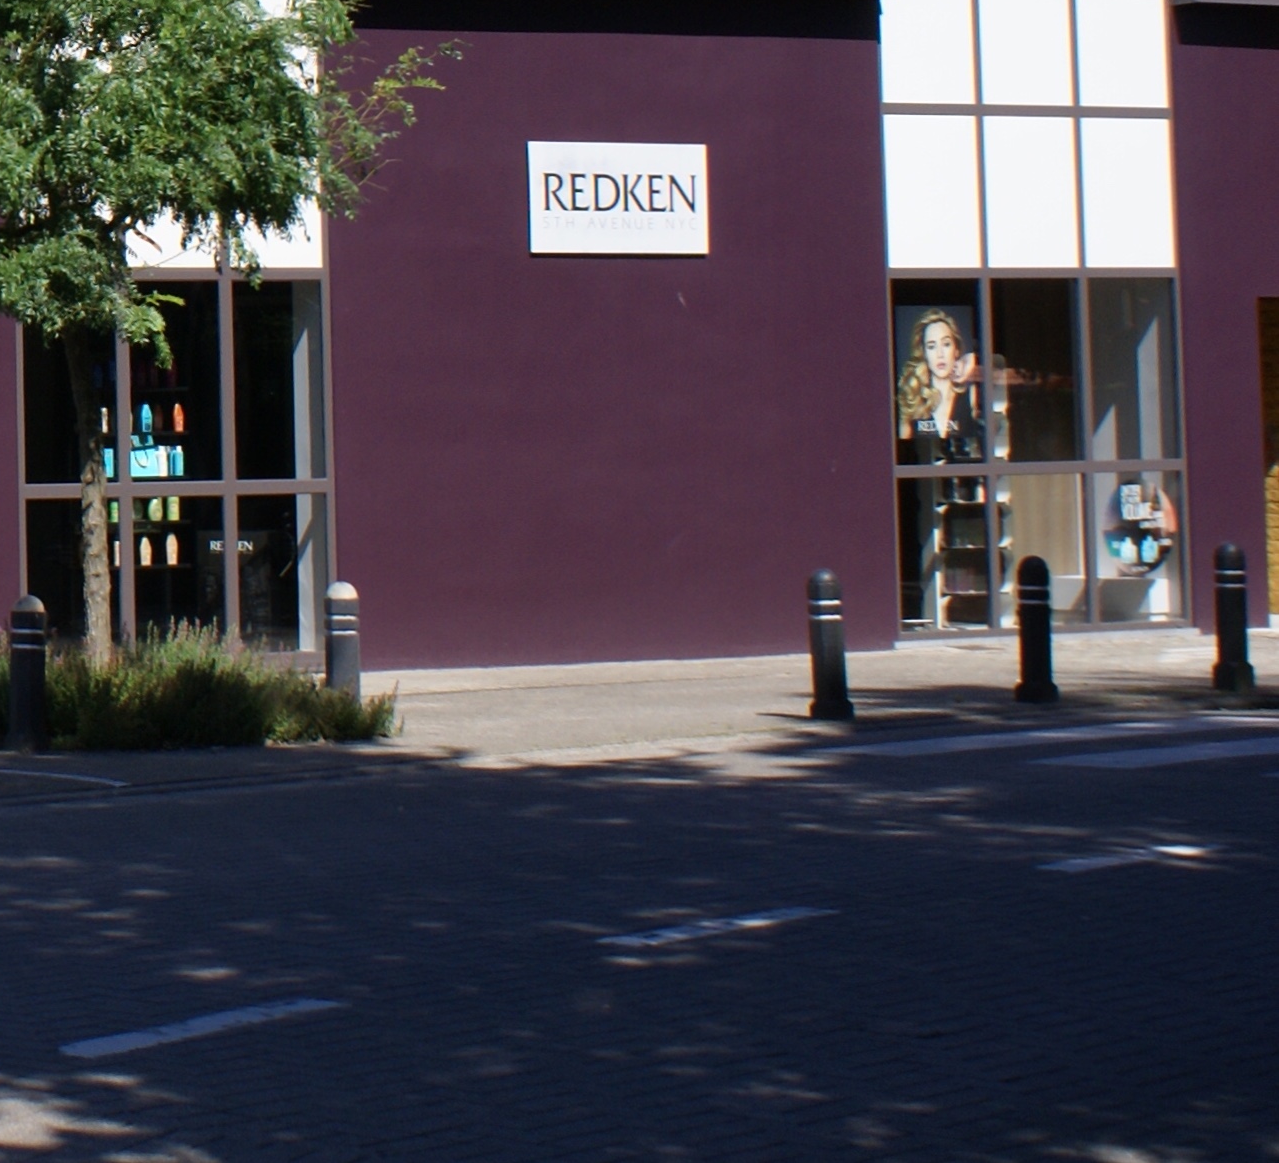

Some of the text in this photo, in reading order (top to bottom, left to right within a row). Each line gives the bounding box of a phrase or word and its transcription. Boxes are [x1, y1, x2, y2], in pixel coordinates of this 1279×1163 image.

[543, 172, 696, 213] REDKEN
[587, 217, 654, 231] AVENUE
[665, 218, 697, 231] NYC
